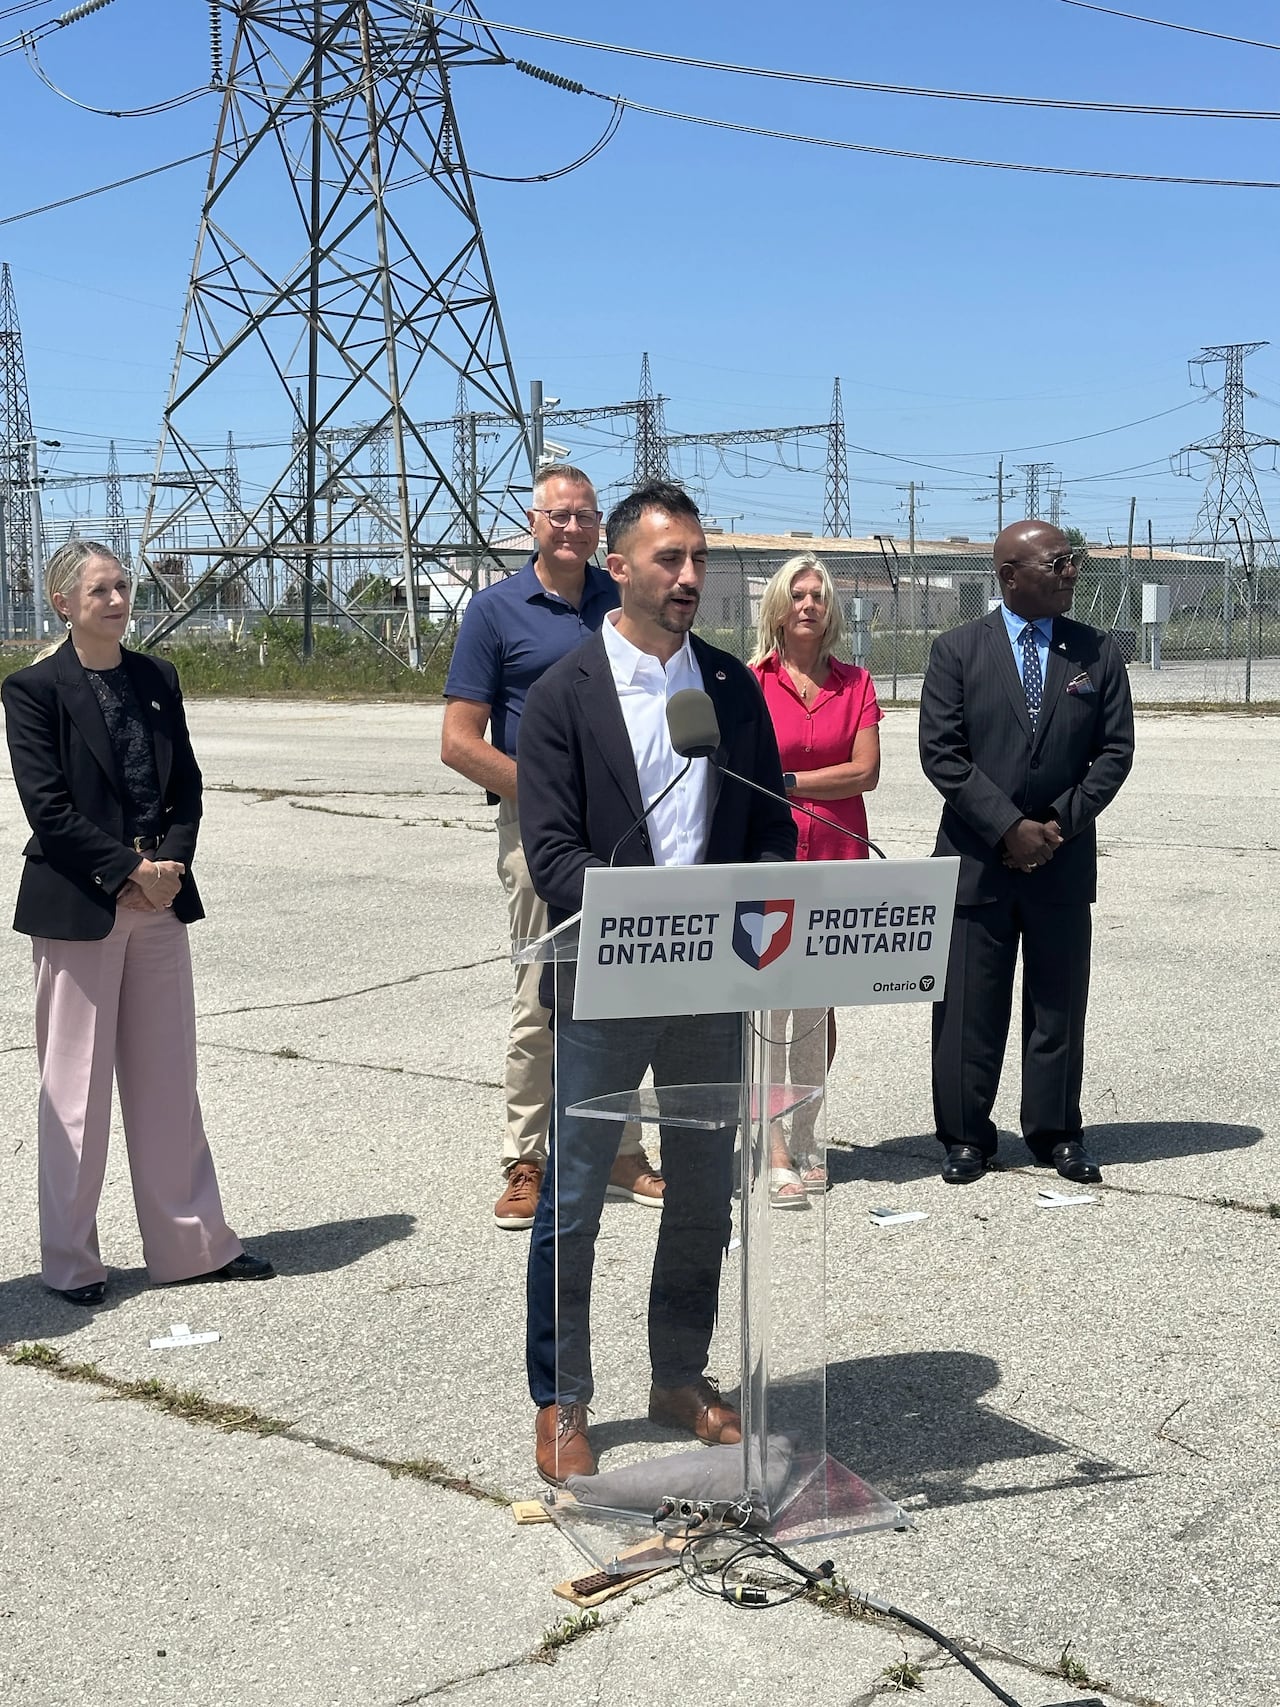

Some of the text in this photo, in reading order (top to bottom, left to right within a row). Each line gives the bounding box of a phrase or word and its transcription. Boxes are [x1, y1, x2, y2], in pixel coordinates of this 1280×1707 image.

[600, 913, 720, 939] PROTECT
[808, 901, 937, 931] PROTÉGER
[597, 940, 714, 966] ONTARIO
[805, 930, 933, 957] L'ONTARIO
[872, 980, 917, 993] Ontario
